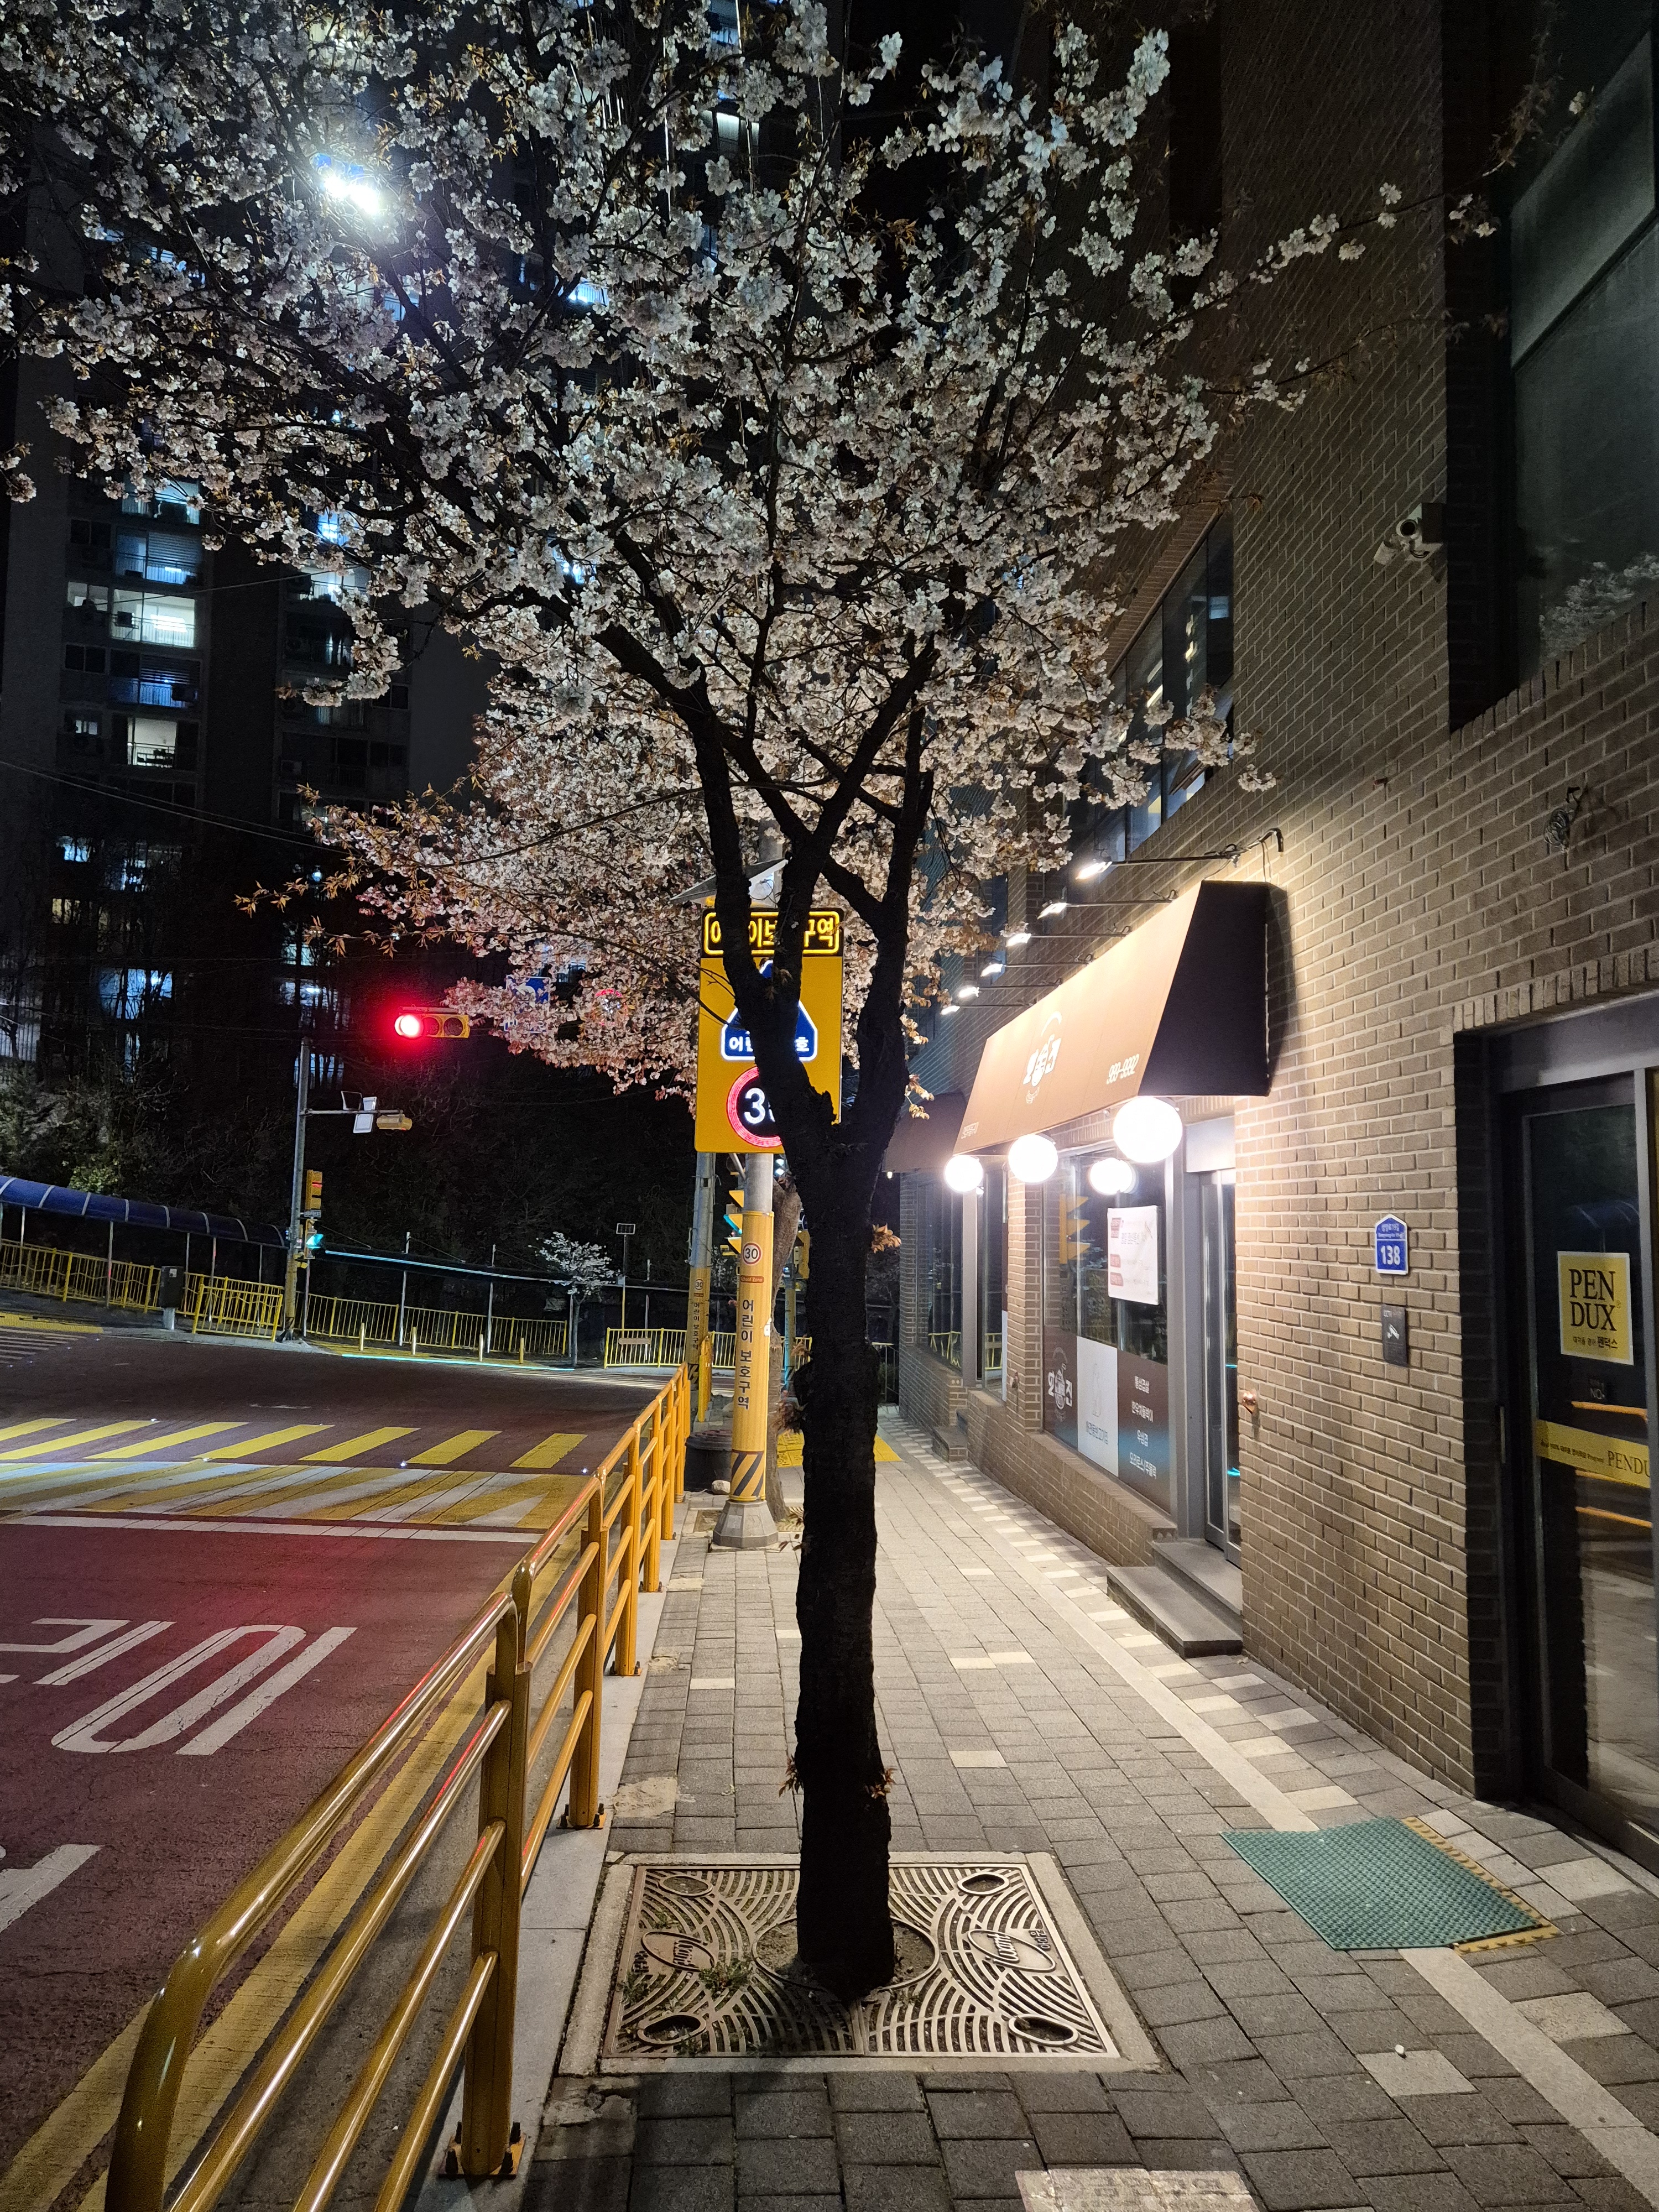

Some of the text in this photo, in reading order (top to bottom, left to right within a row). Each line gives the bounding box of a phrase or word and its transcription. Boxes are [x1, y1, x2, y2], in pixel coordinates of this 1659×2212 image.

[744, 1087, 775, 1124] 3
[745, 1248, 759, 1259] 30
[1380, 1245, 1400, 1265] 138
[1568, 1269, 1616, 1301] PEN
[1569, 1301, 1618, 1332] DUX
[737, 1299, 754, 1410] 어린이 보호구역
[1137, 1430, 1149, 1447] 우삼겹
